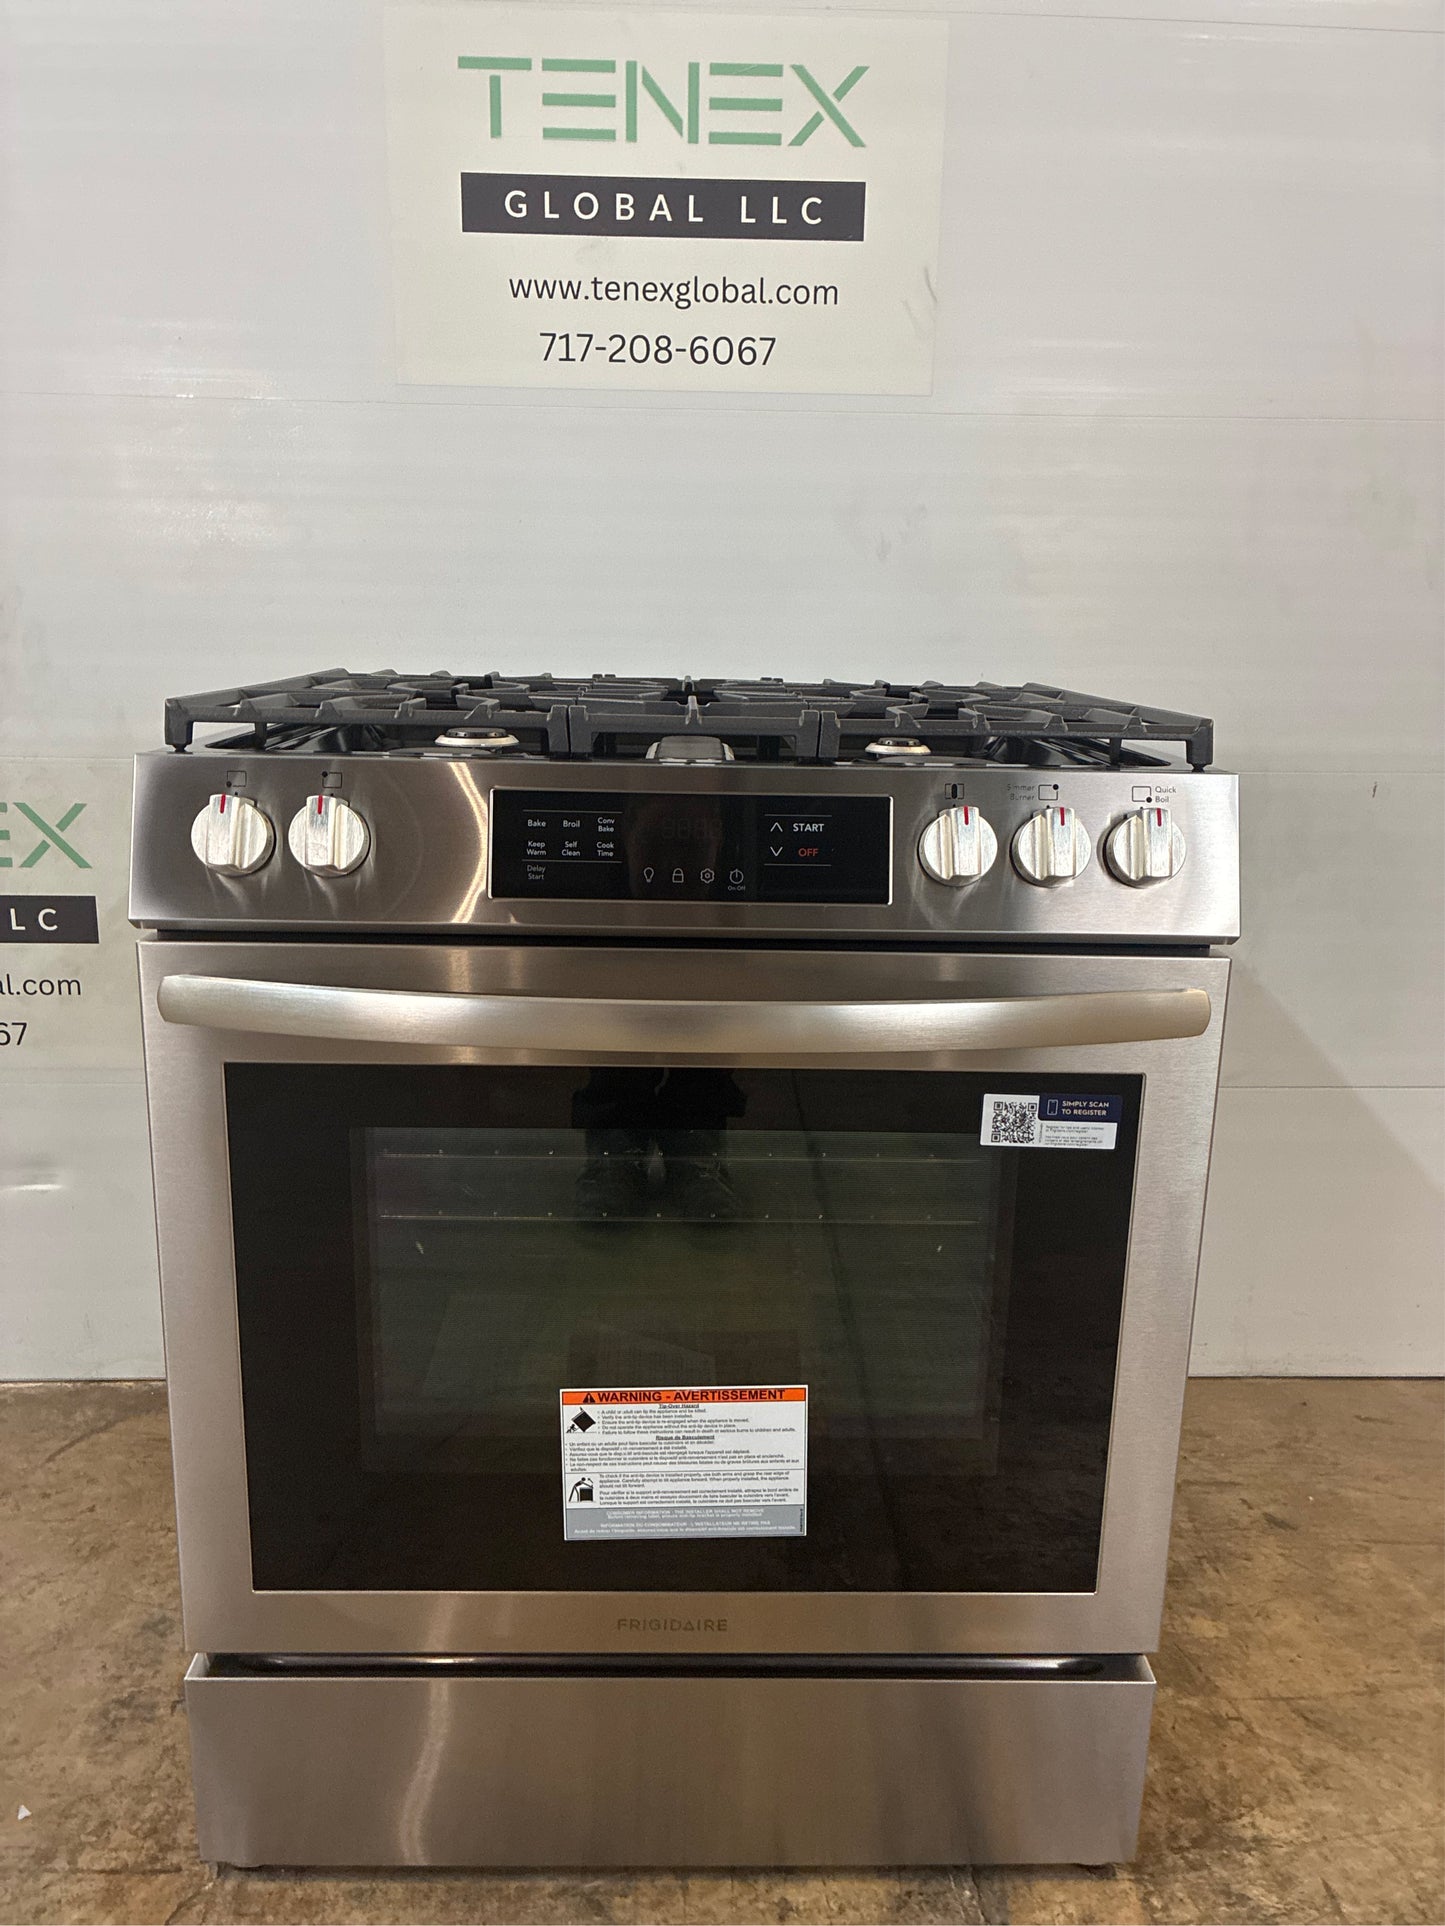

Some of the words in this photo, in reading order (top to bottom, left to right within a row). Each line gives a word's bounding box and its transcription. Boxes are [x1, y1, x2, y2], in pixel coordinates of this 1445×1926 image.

[457, 56, 870, 148] TENEX
[504, 190, 704, 222] GLOBAL
[740, 195, 823, 225] LLC
[509, 276, 838, 310] www.tenexglobal.com
[539, 333, 777, 366] 717-208-6067
[528, 819, 546, 827] Bake
[793, 823, 824, 832] START
[0, 802, 93, 869] X
[799, 848, 819, 857] OFF
[527, 865, 546, 873] Delay
[597, 1391, 662, 1402] WARNING
[673, 1389, 785, 1402] AVERTISSEMENT
[617, 1618, 727, 1632] FRIGIDAIRE
